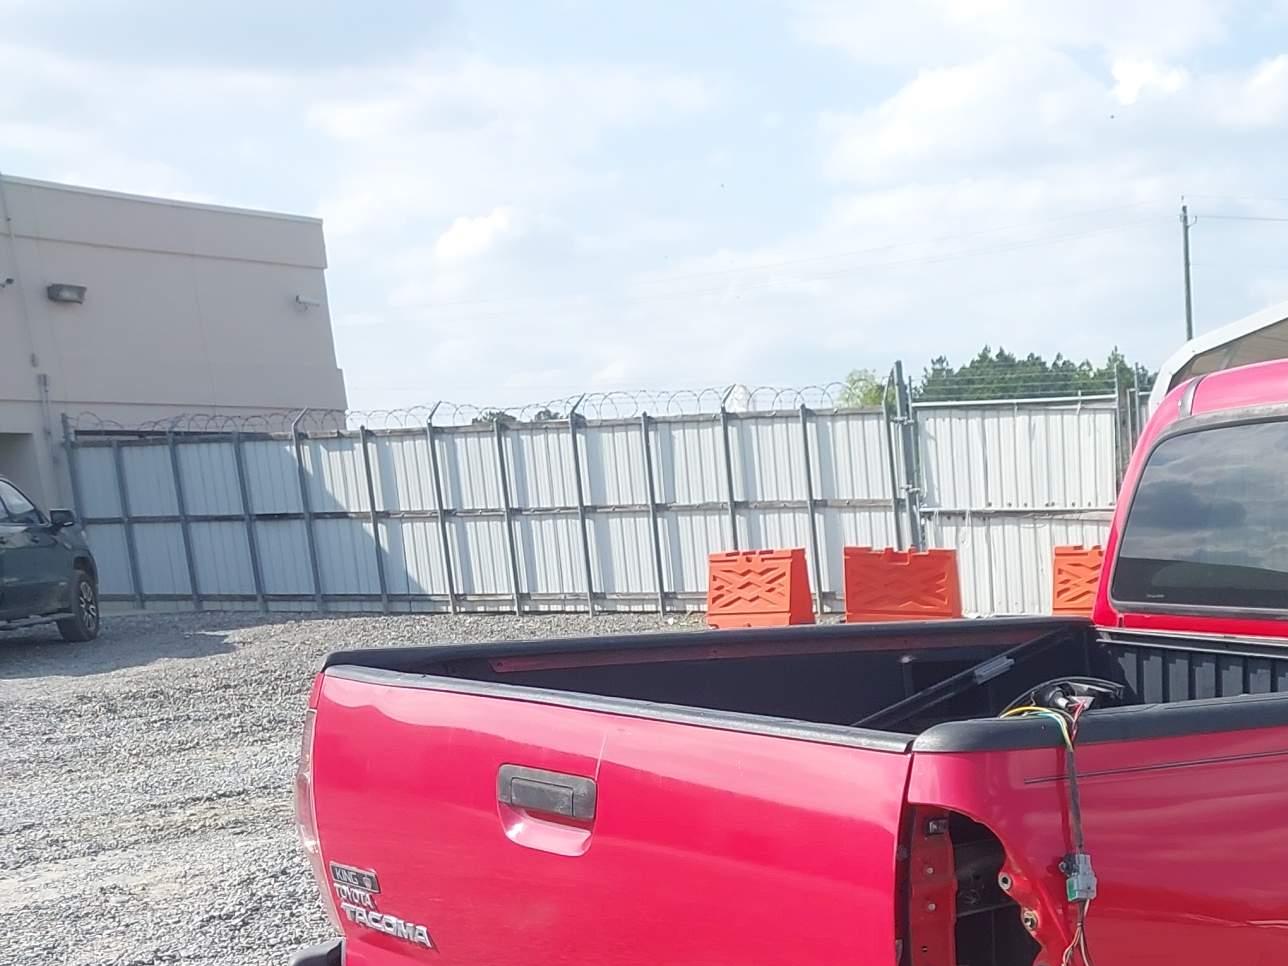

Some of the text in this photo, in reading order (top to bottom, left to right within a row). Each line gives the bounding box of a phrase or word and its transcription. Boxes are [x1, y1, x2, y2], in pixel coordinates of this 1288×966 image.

[335, 867, 359, 885] KING
[334, 883, 374, 909] TOYOTA
[341, 902, 433, 948] TACOMA
